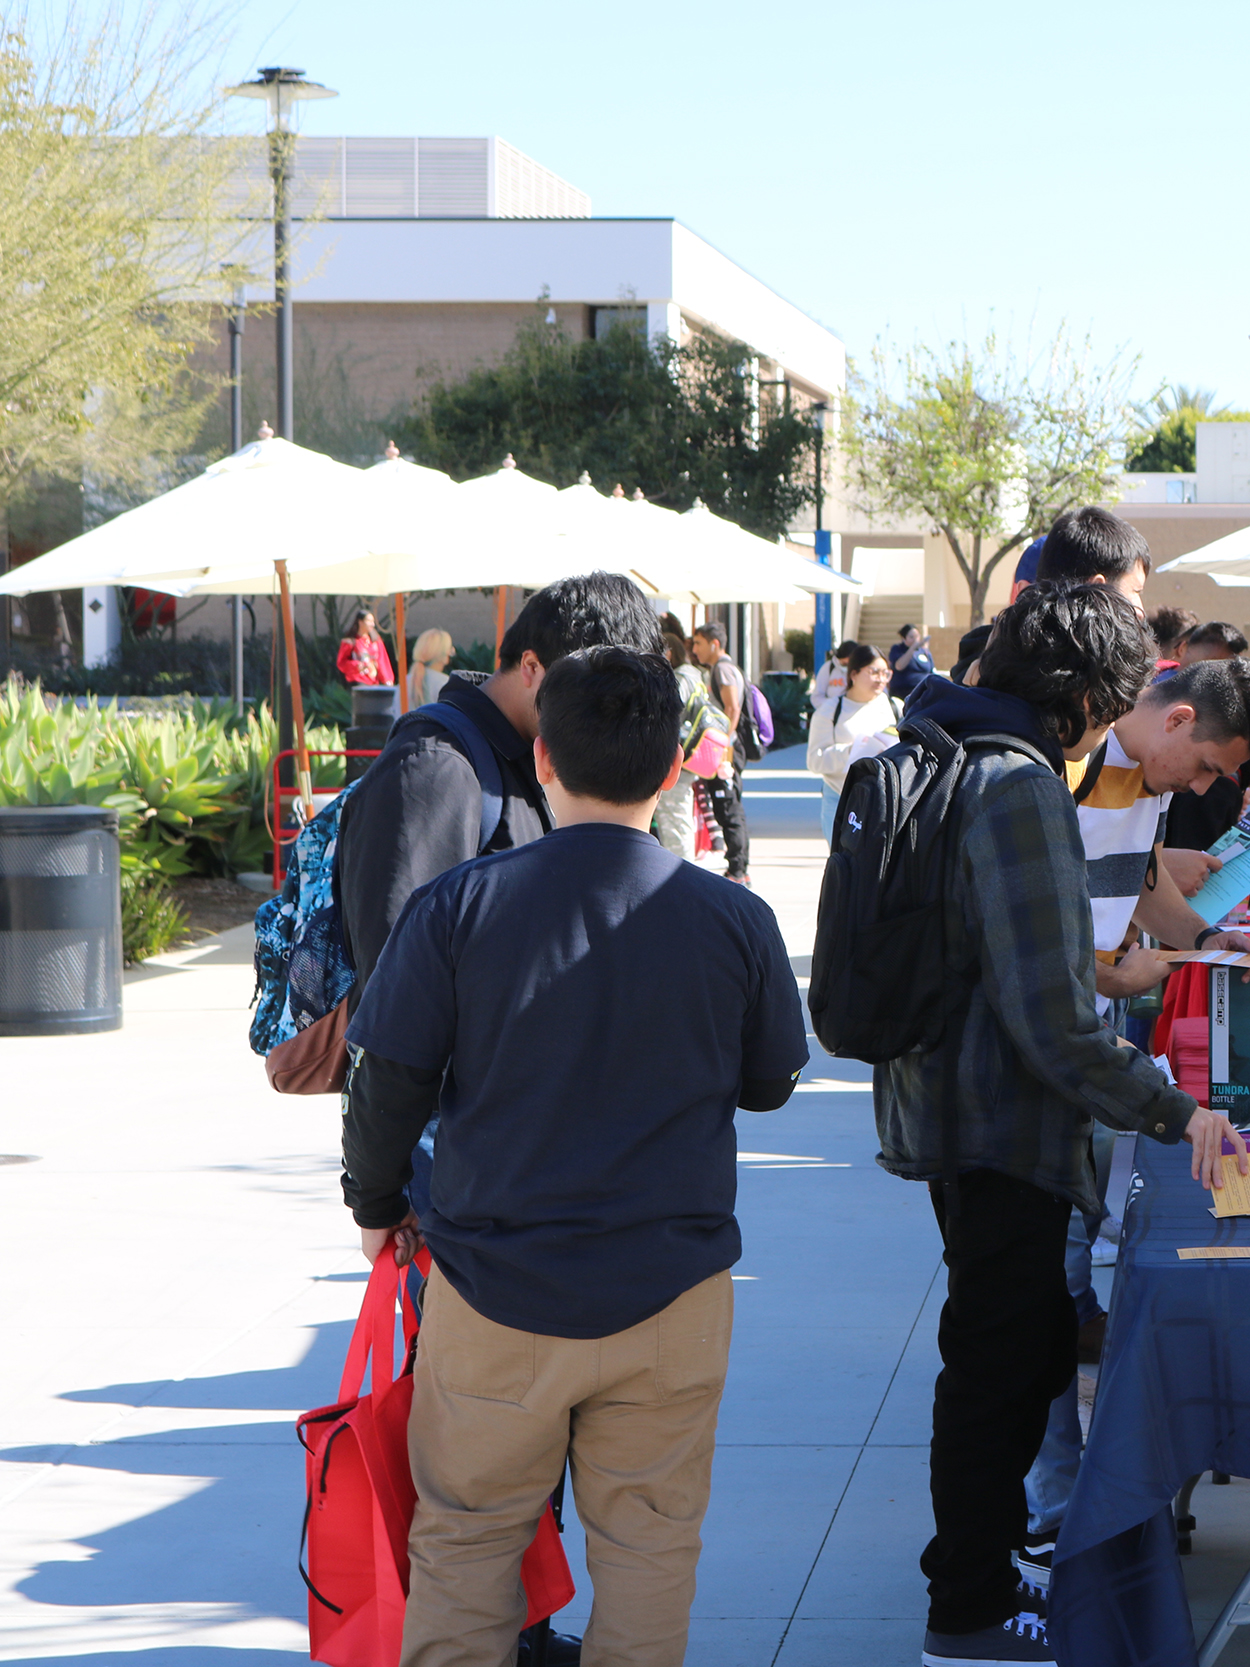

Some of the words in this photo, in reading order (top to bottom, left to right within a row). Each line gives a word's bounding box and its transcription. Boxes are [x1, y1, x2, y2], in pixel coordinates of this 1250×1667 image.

[1215, 971, 1227, 1026] basecamp
[1211, 1085, 1250, 1095] TUNDRA
[1211, 1095, 1235, 1104] BOTTLE
